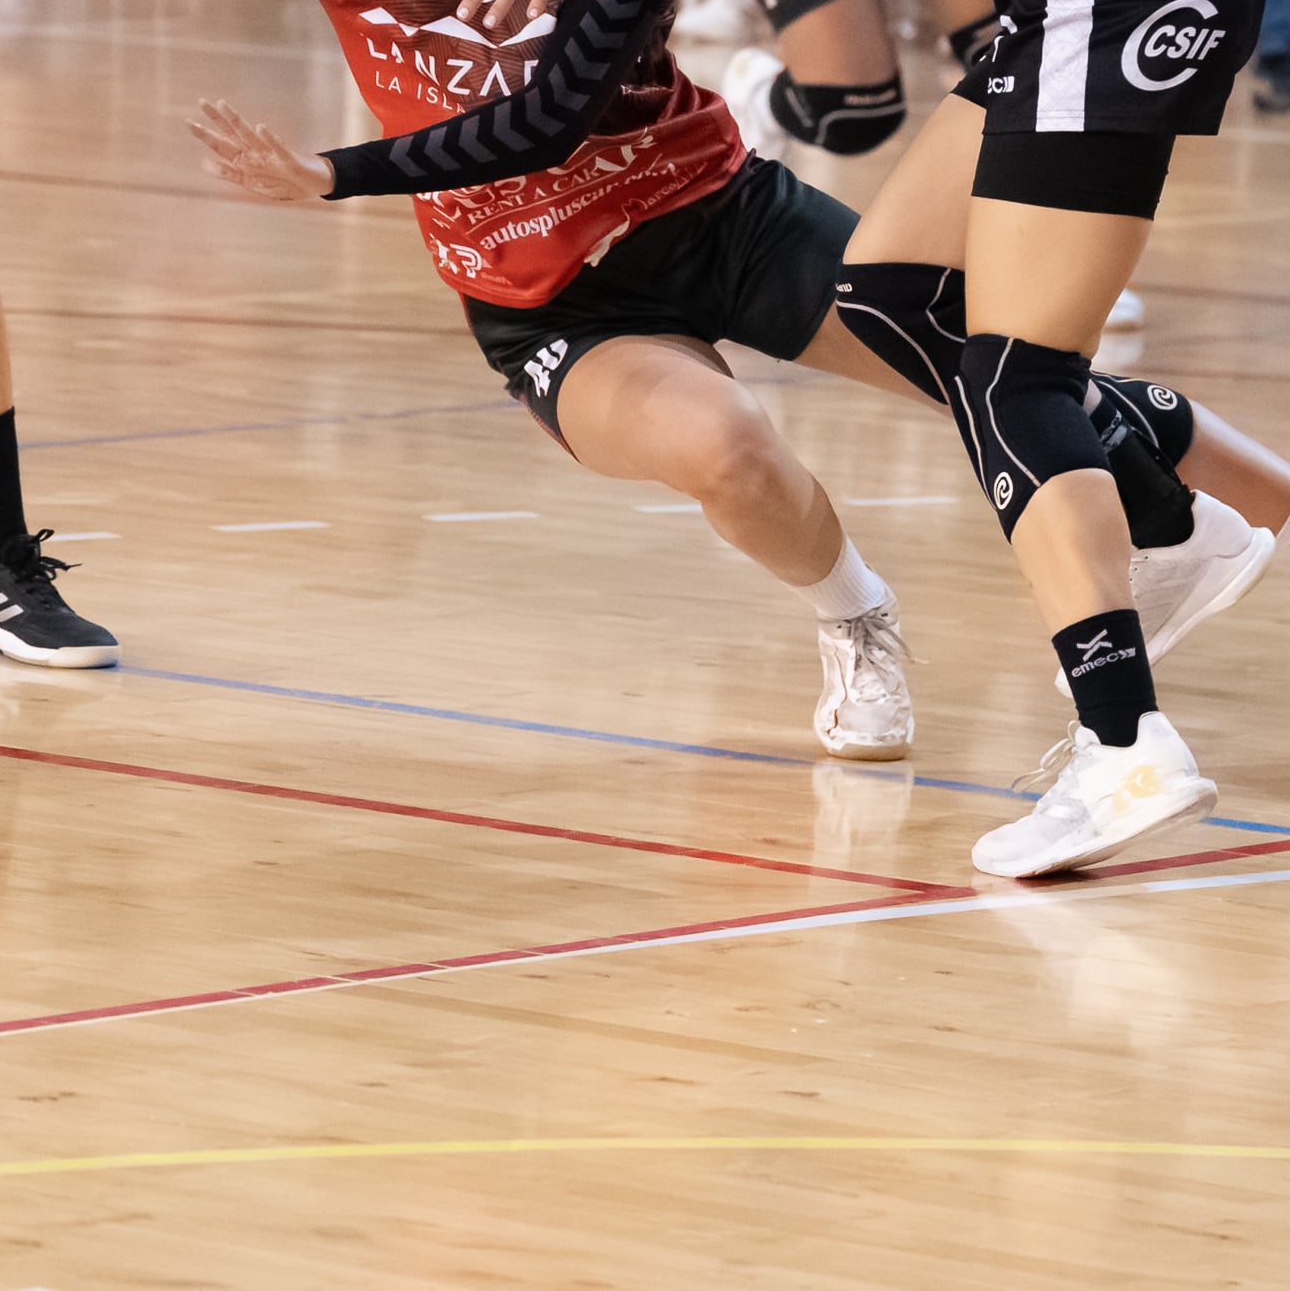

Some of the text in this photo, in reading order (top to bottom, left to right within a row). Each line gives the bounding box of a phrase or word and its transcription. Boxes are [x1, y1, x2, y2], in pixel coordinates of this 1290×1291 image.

[1143, 24, 1226, 61] CSIF
[374, 71, 402, 94] LA
[467, 193, 525, 225] RENT
[534, 187, 546, 200] A
[552, 168, 601, 193] CAR
